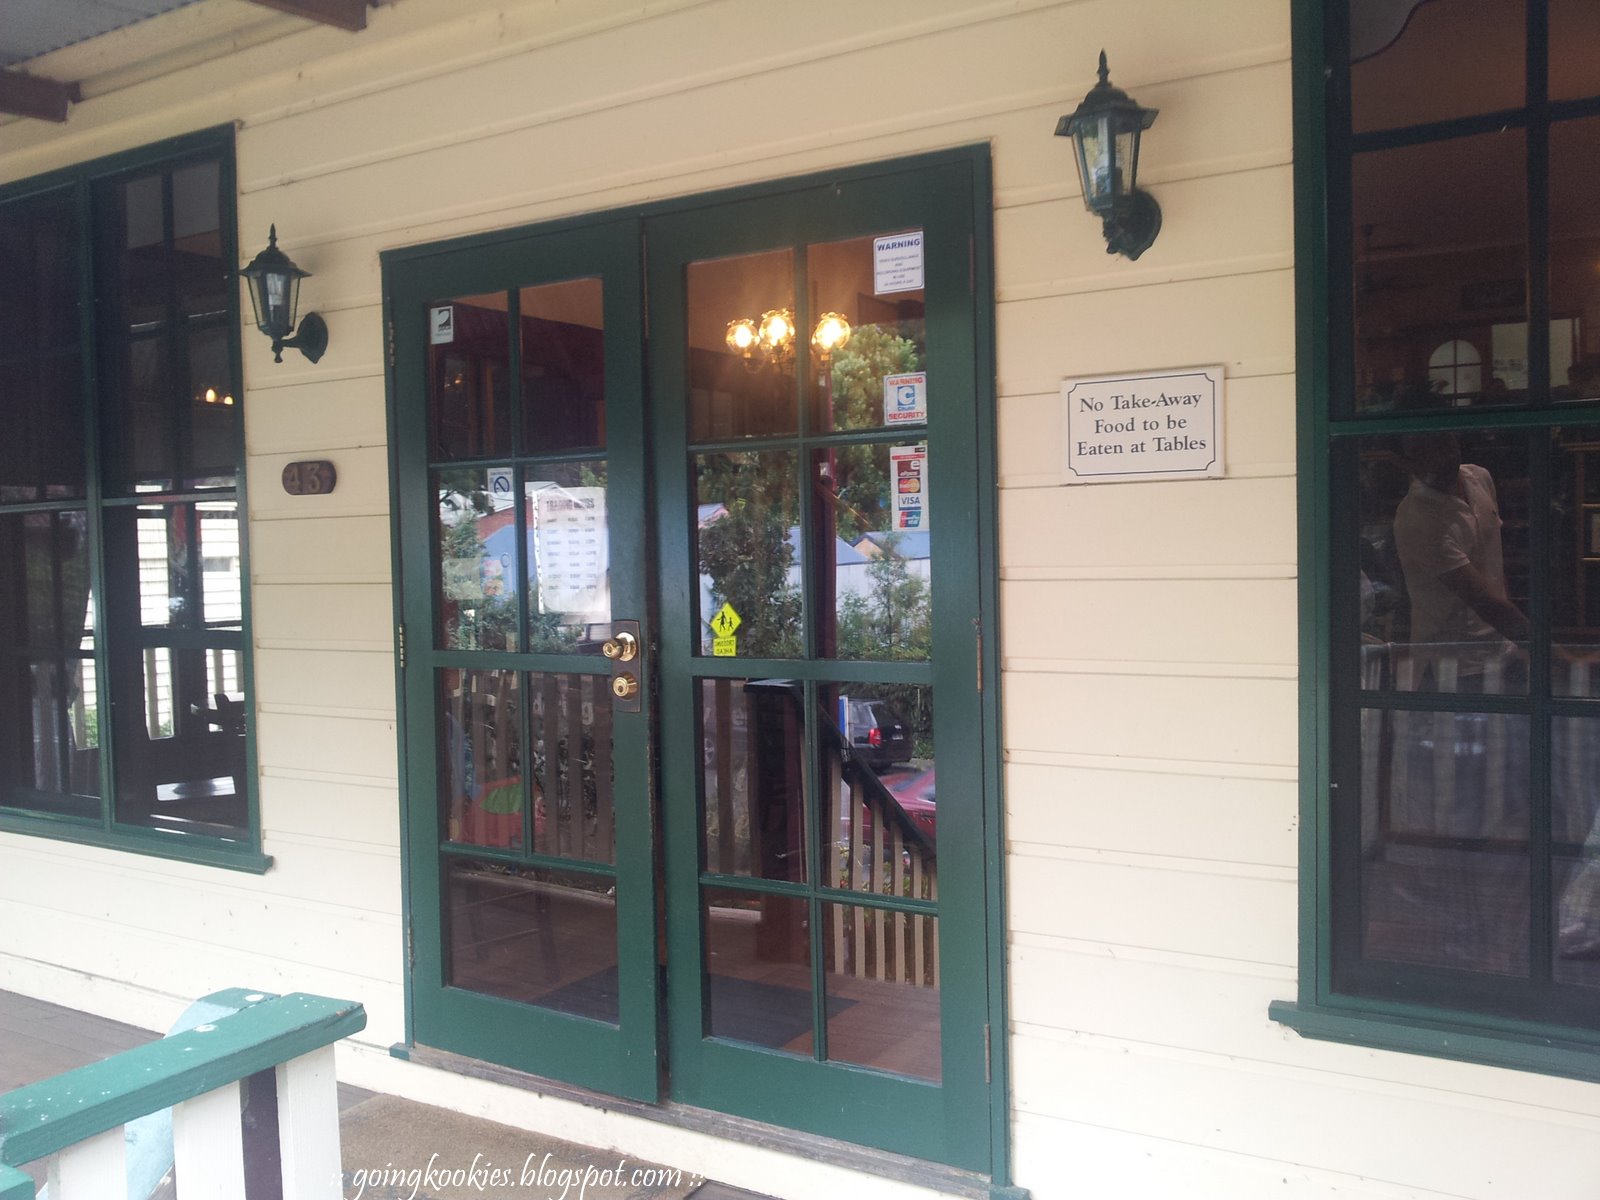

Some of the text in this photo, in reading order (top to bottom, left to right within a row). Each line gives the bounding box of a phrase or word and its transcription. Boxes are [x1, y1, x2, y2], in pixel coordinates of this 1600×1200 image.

[877, 239, 920, 251] WARNING
[888, 377, 922, 386] WARNING
[1079, 392, 1202, 412] No Take-Away
[888, 411, 924, 420] SECURITY
[1094, 415, 1187, 434] Food to be
[1077, 436, 1206, 456] Eaten at Tables
[901, 496, 920, 504] VISA
